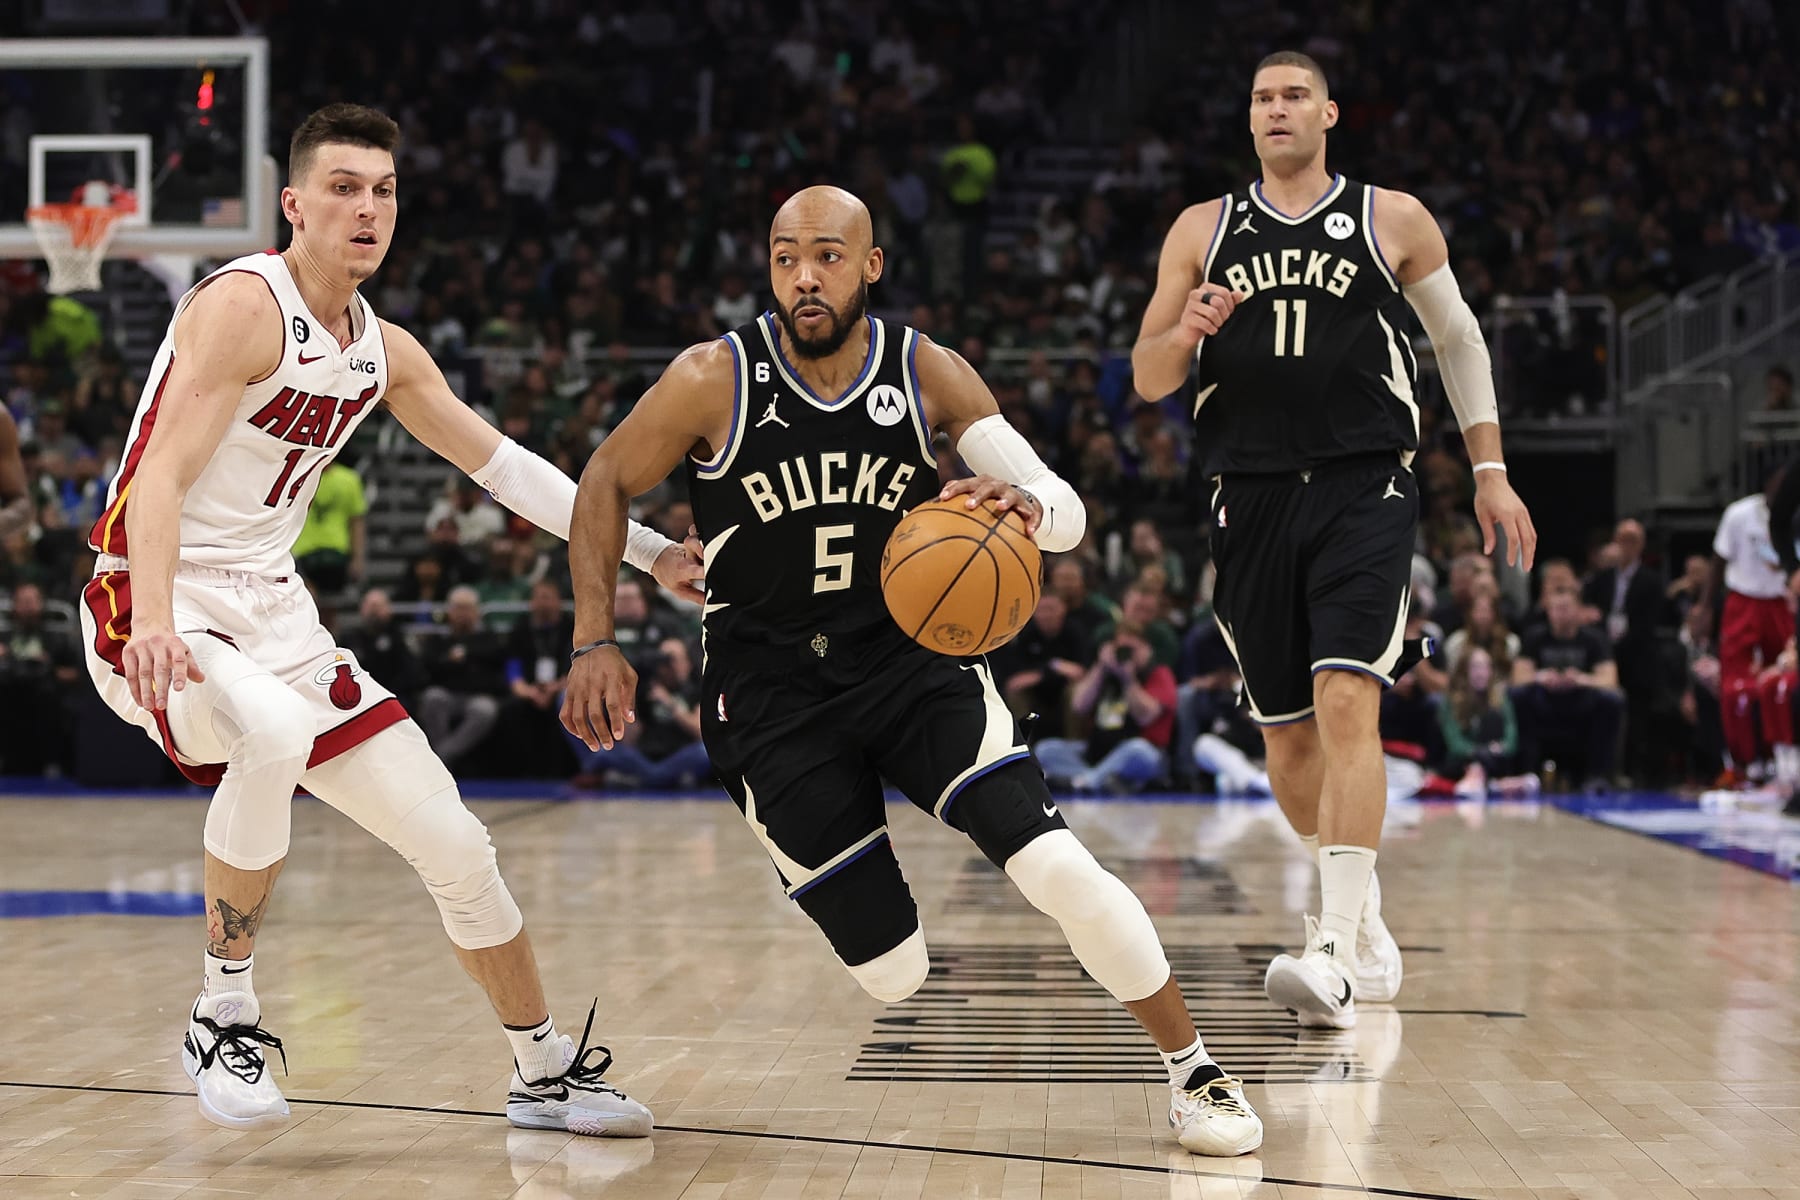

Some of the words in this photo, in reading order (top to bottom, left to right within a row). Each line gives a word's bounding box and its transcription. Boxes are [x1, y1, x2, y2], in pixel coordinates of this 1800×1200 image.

[1225, 249, 1359, 303] BUCKS
[1273, 299, 1307, 357] 11
[756, 362, 770, 382] 6
[247, 380, 378, 449] HEAT
[740, 452, 916, 523] BUCKS
[813, 523, 854, 594] 5
